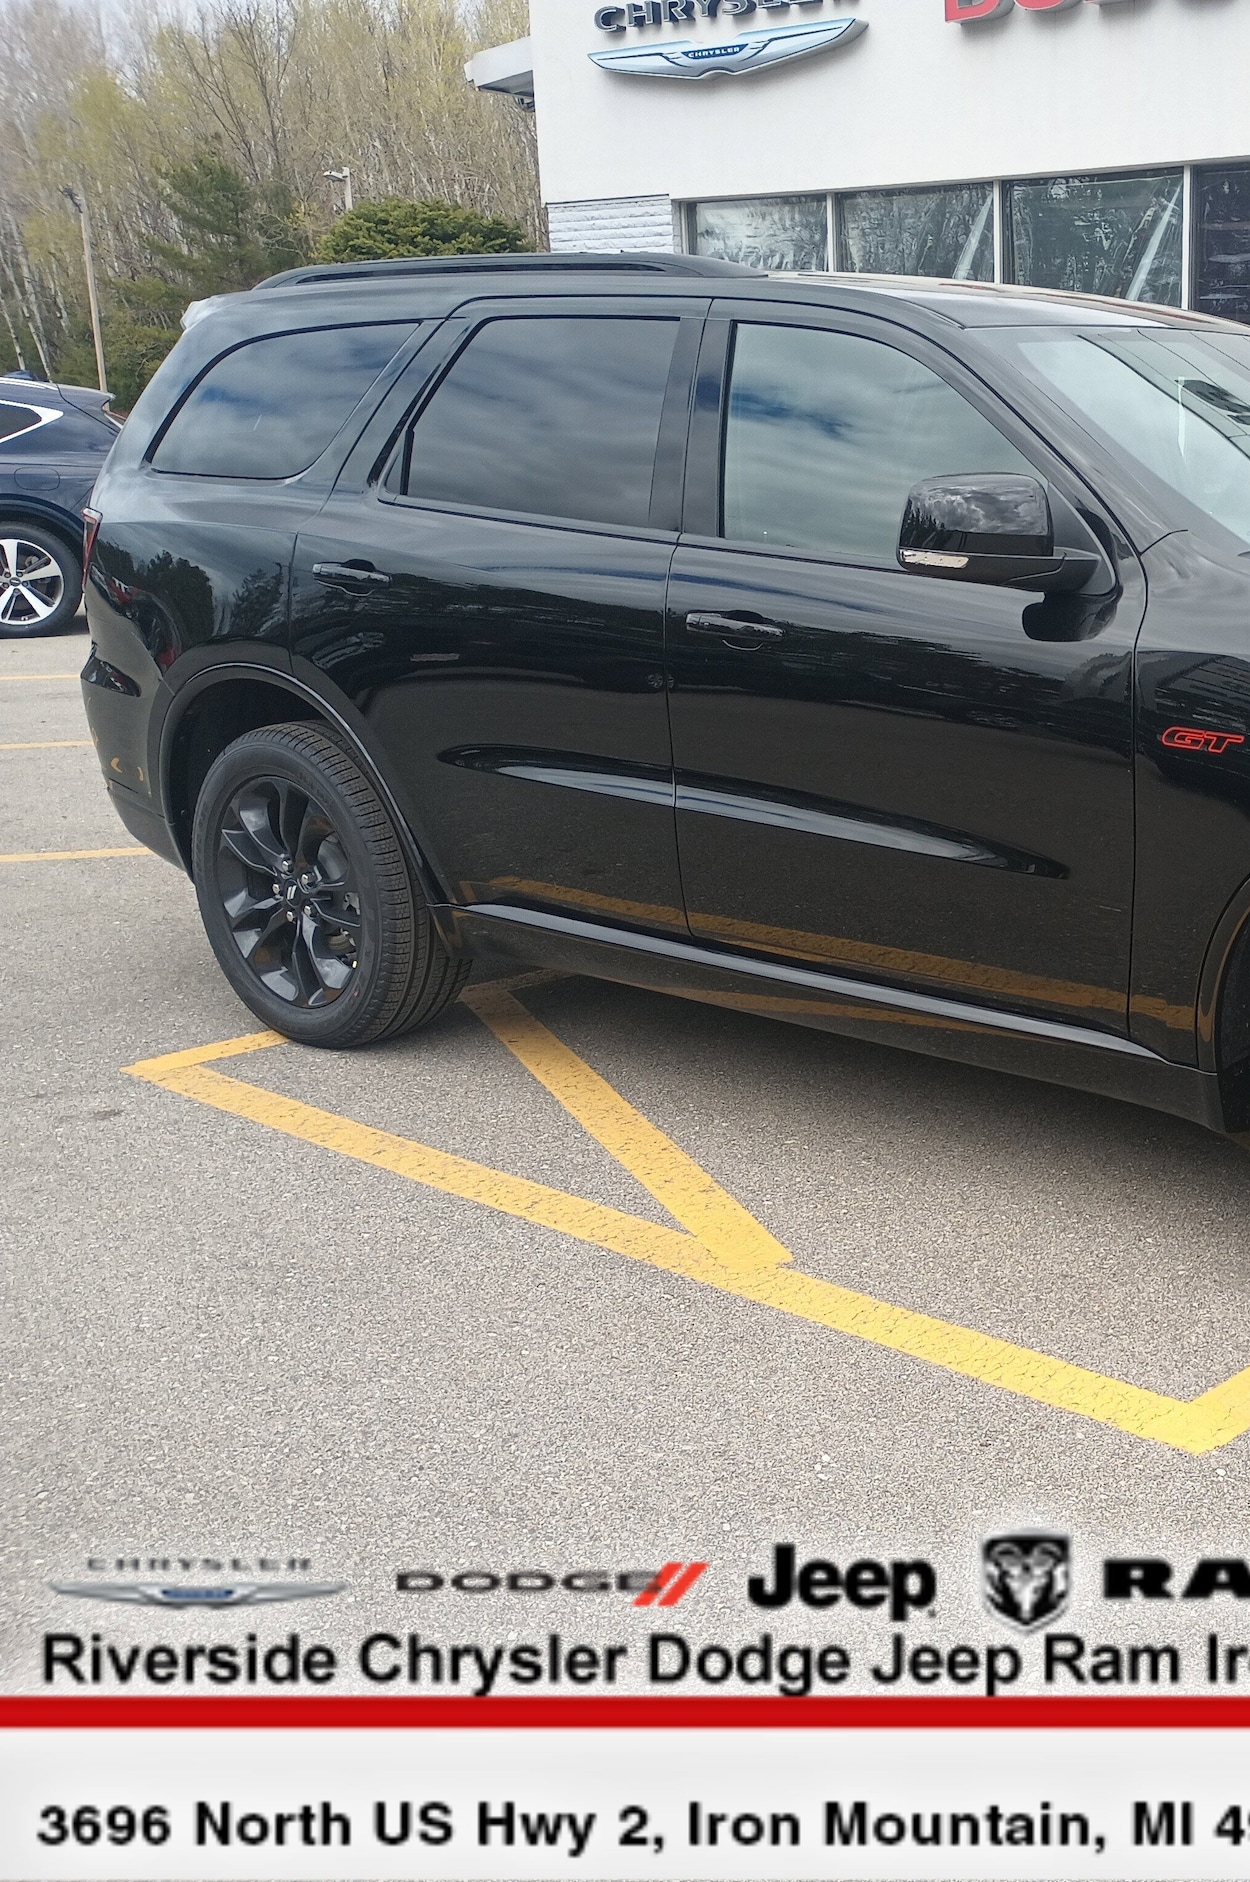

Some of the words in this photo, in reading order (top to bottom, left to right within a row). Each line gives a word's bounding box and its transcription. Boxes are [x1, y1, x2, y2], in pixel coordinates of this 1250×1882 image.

[594, 0, 836, 33] CHRYS
[688, 46, 740, 59] CHRYSLER
[1161, 725, 1245, 753] GT
